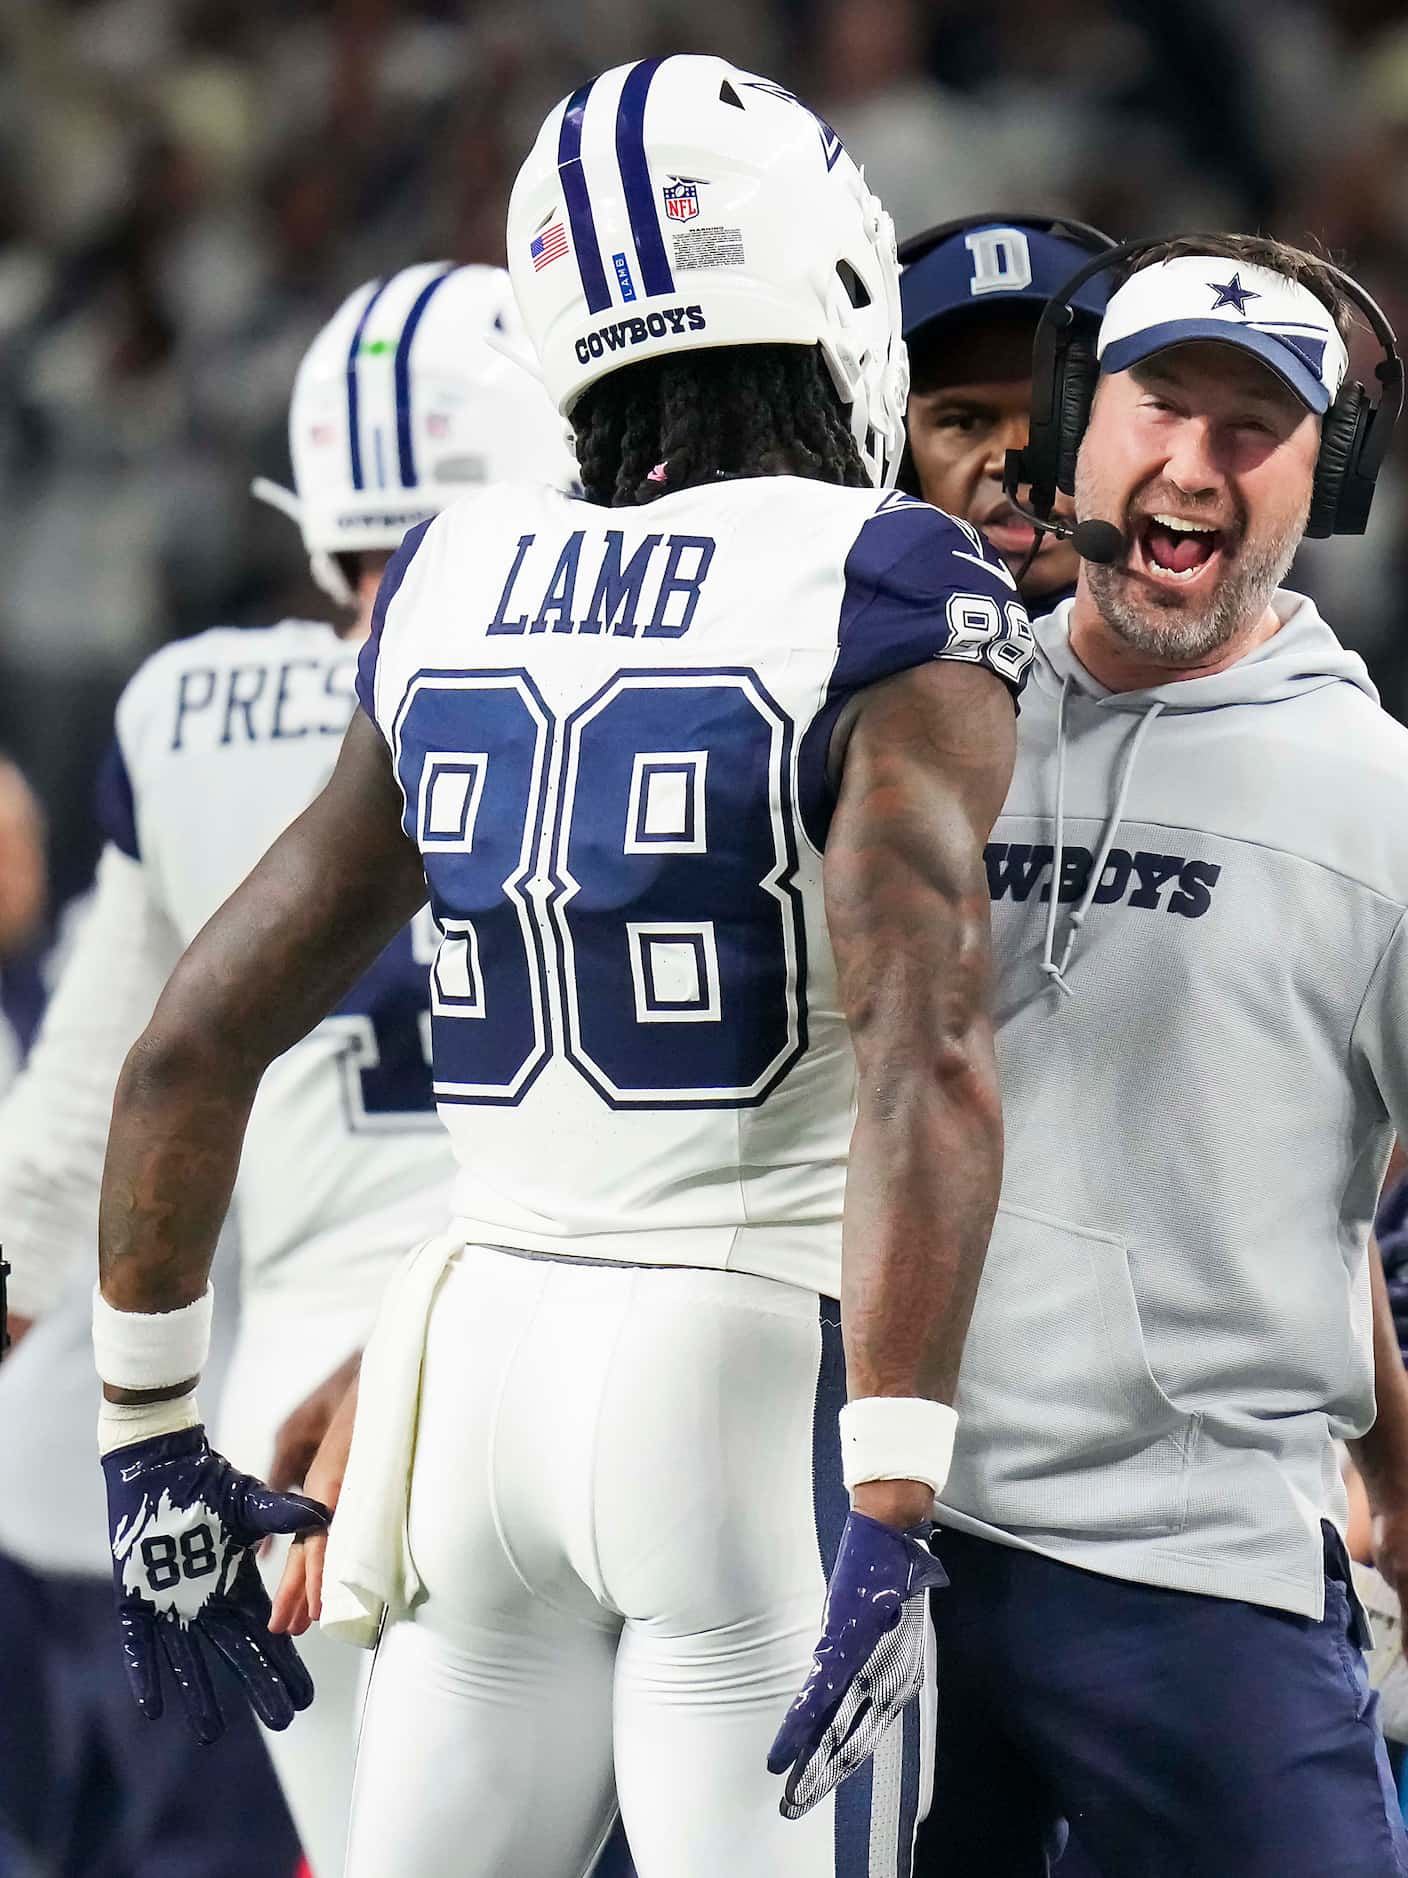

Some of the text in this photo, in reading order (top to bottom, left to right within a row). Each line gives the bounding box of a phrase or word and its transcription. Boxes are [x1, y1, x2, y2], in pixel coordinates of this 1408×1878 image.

[668, 199, 696, 218] NFL
[615, 258, 633, 297] LAMB
[965, 228, 1032, 295] D
[574, 304, 706, 365] COWBOYS
[486, 530, 716, 639] LAMB
[933, 592, 1036, 683] 88
[391, 667, 809, 1112] 88
[141, 1524, 216, 1591] 88
